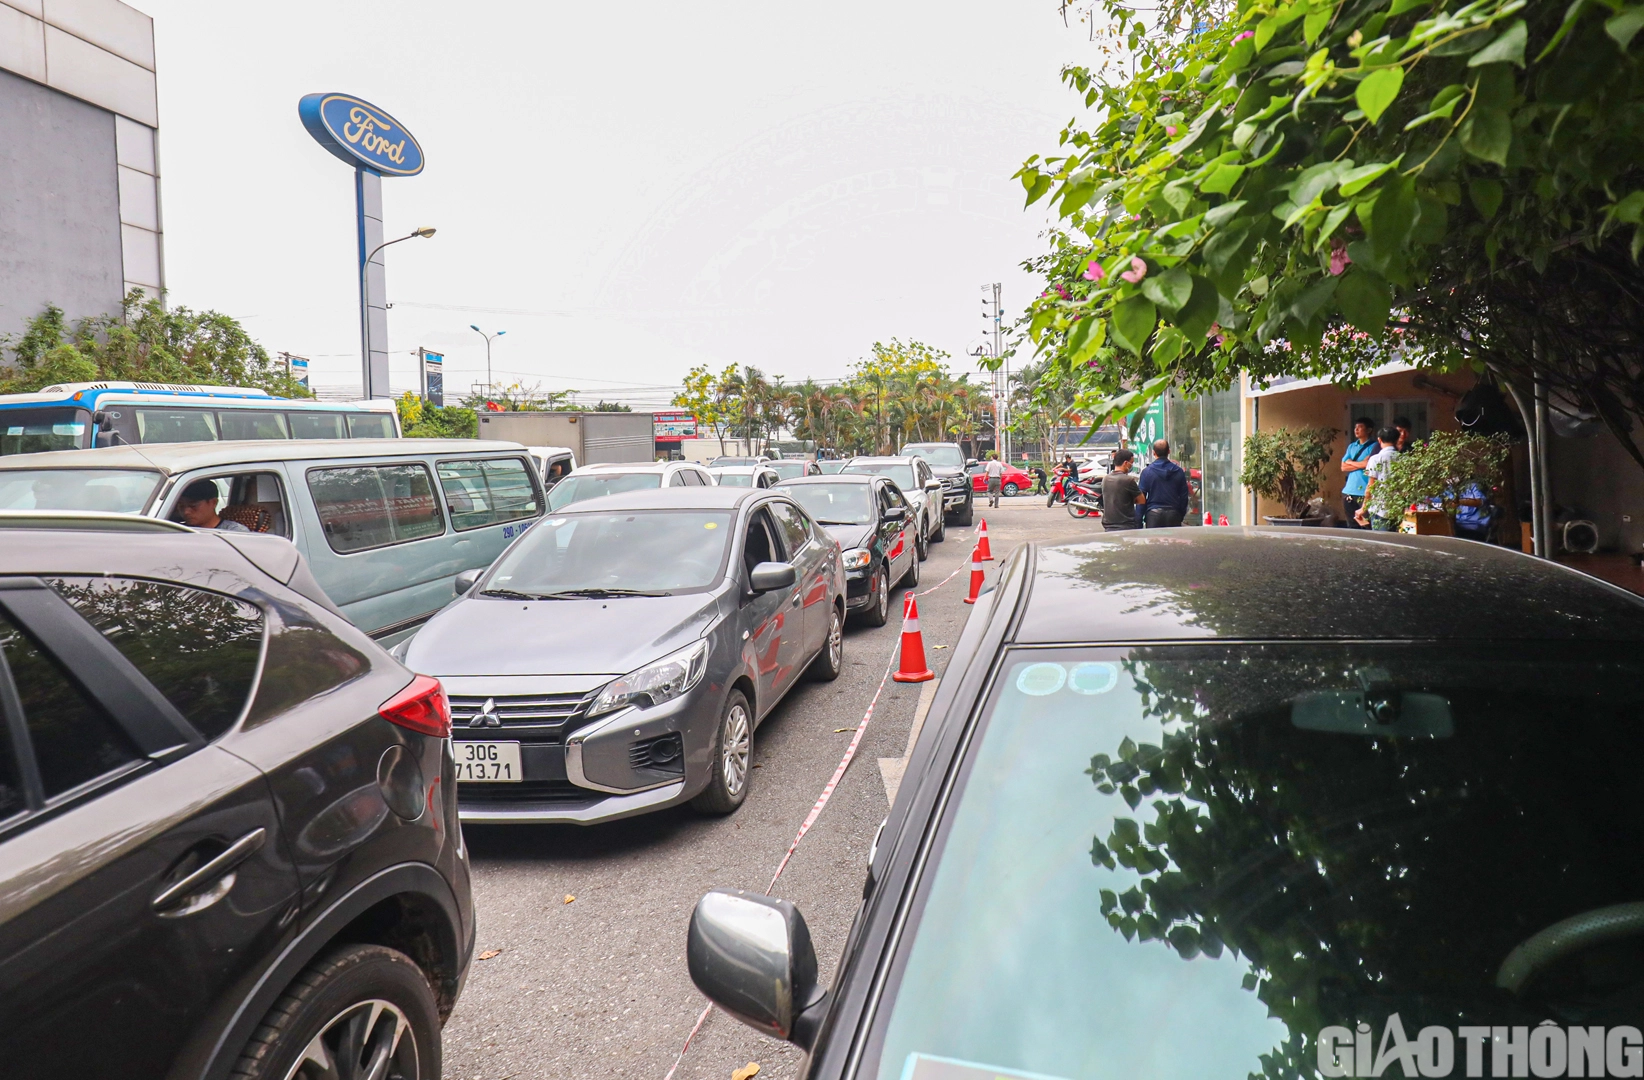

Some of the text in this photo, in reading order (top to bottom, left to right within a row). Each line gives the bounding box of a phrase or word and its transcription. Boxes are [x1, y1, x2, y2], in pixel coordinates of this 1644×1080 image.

[343, 106, 406, 164] Ford
[465, 744, 498, 761] 30G
[455, 763, 512, 780] 713.71
